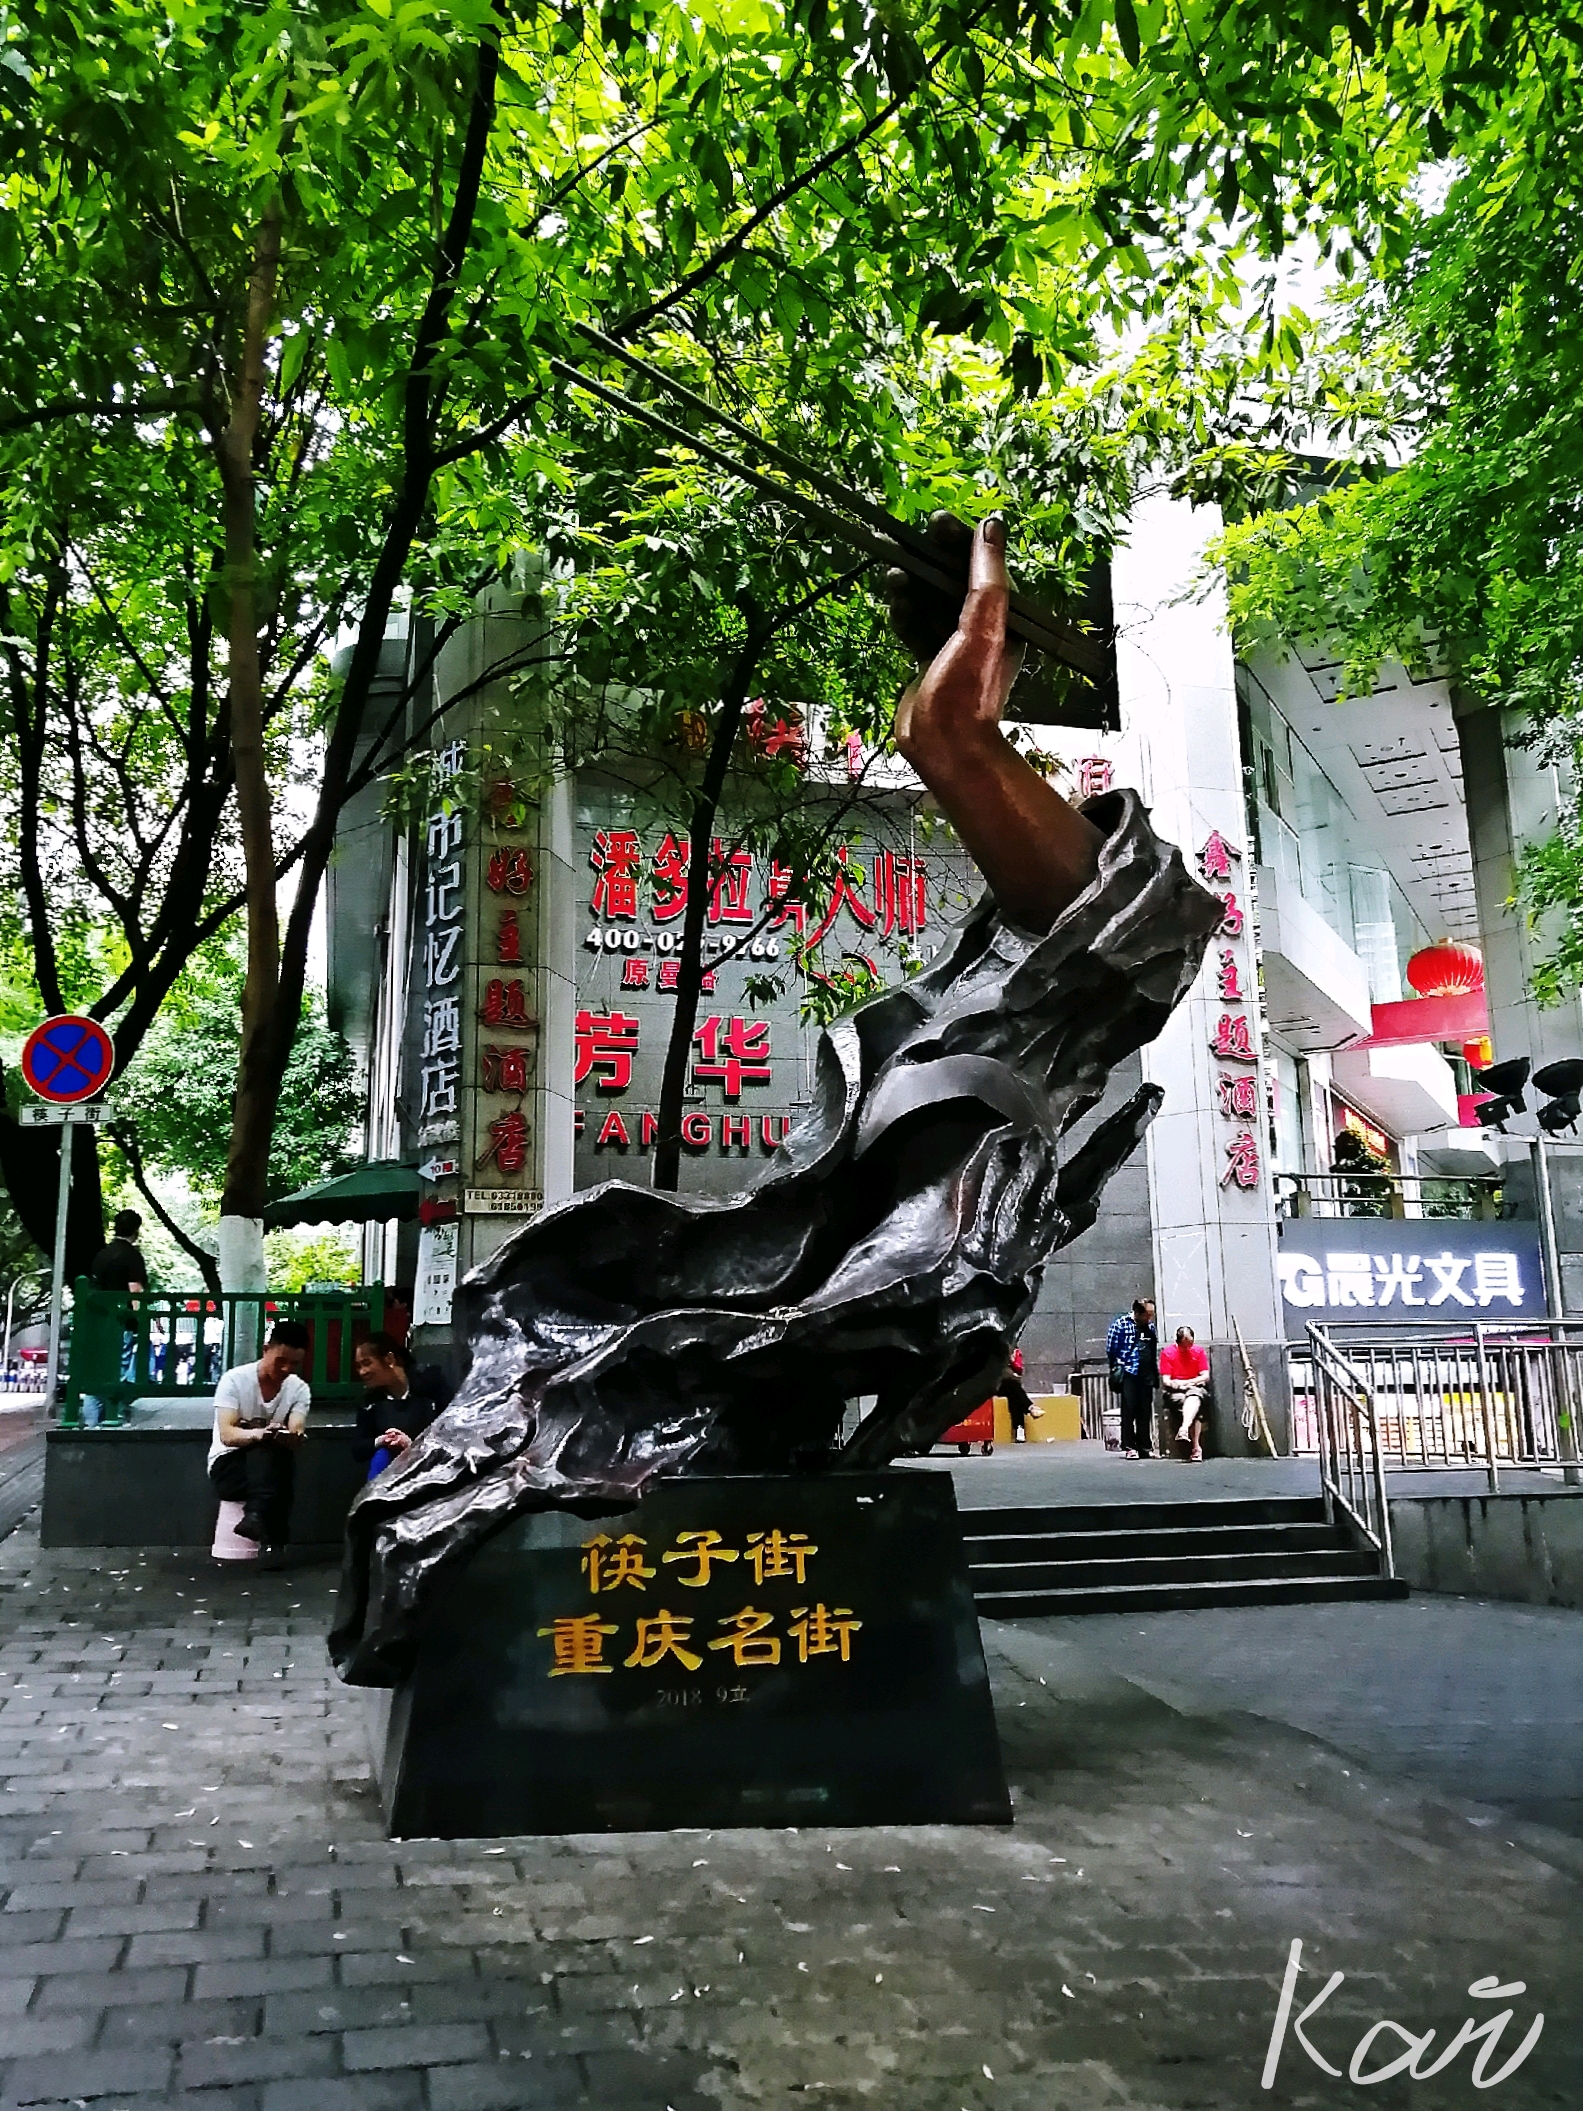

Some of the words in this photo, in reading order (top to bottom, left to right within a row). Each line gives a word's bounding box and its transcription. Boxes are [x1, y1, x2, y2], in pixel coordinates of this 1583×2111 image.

[587, 928, 779, 957] 400-02-9766
[574, 1010, 772, 1097] 芳华
[1326, 1251, 1525, 1307] 晨光文具
[580, 1529, 819, 1594] 筷子街
[536, 1603, 863, 1678] 重庆名街
